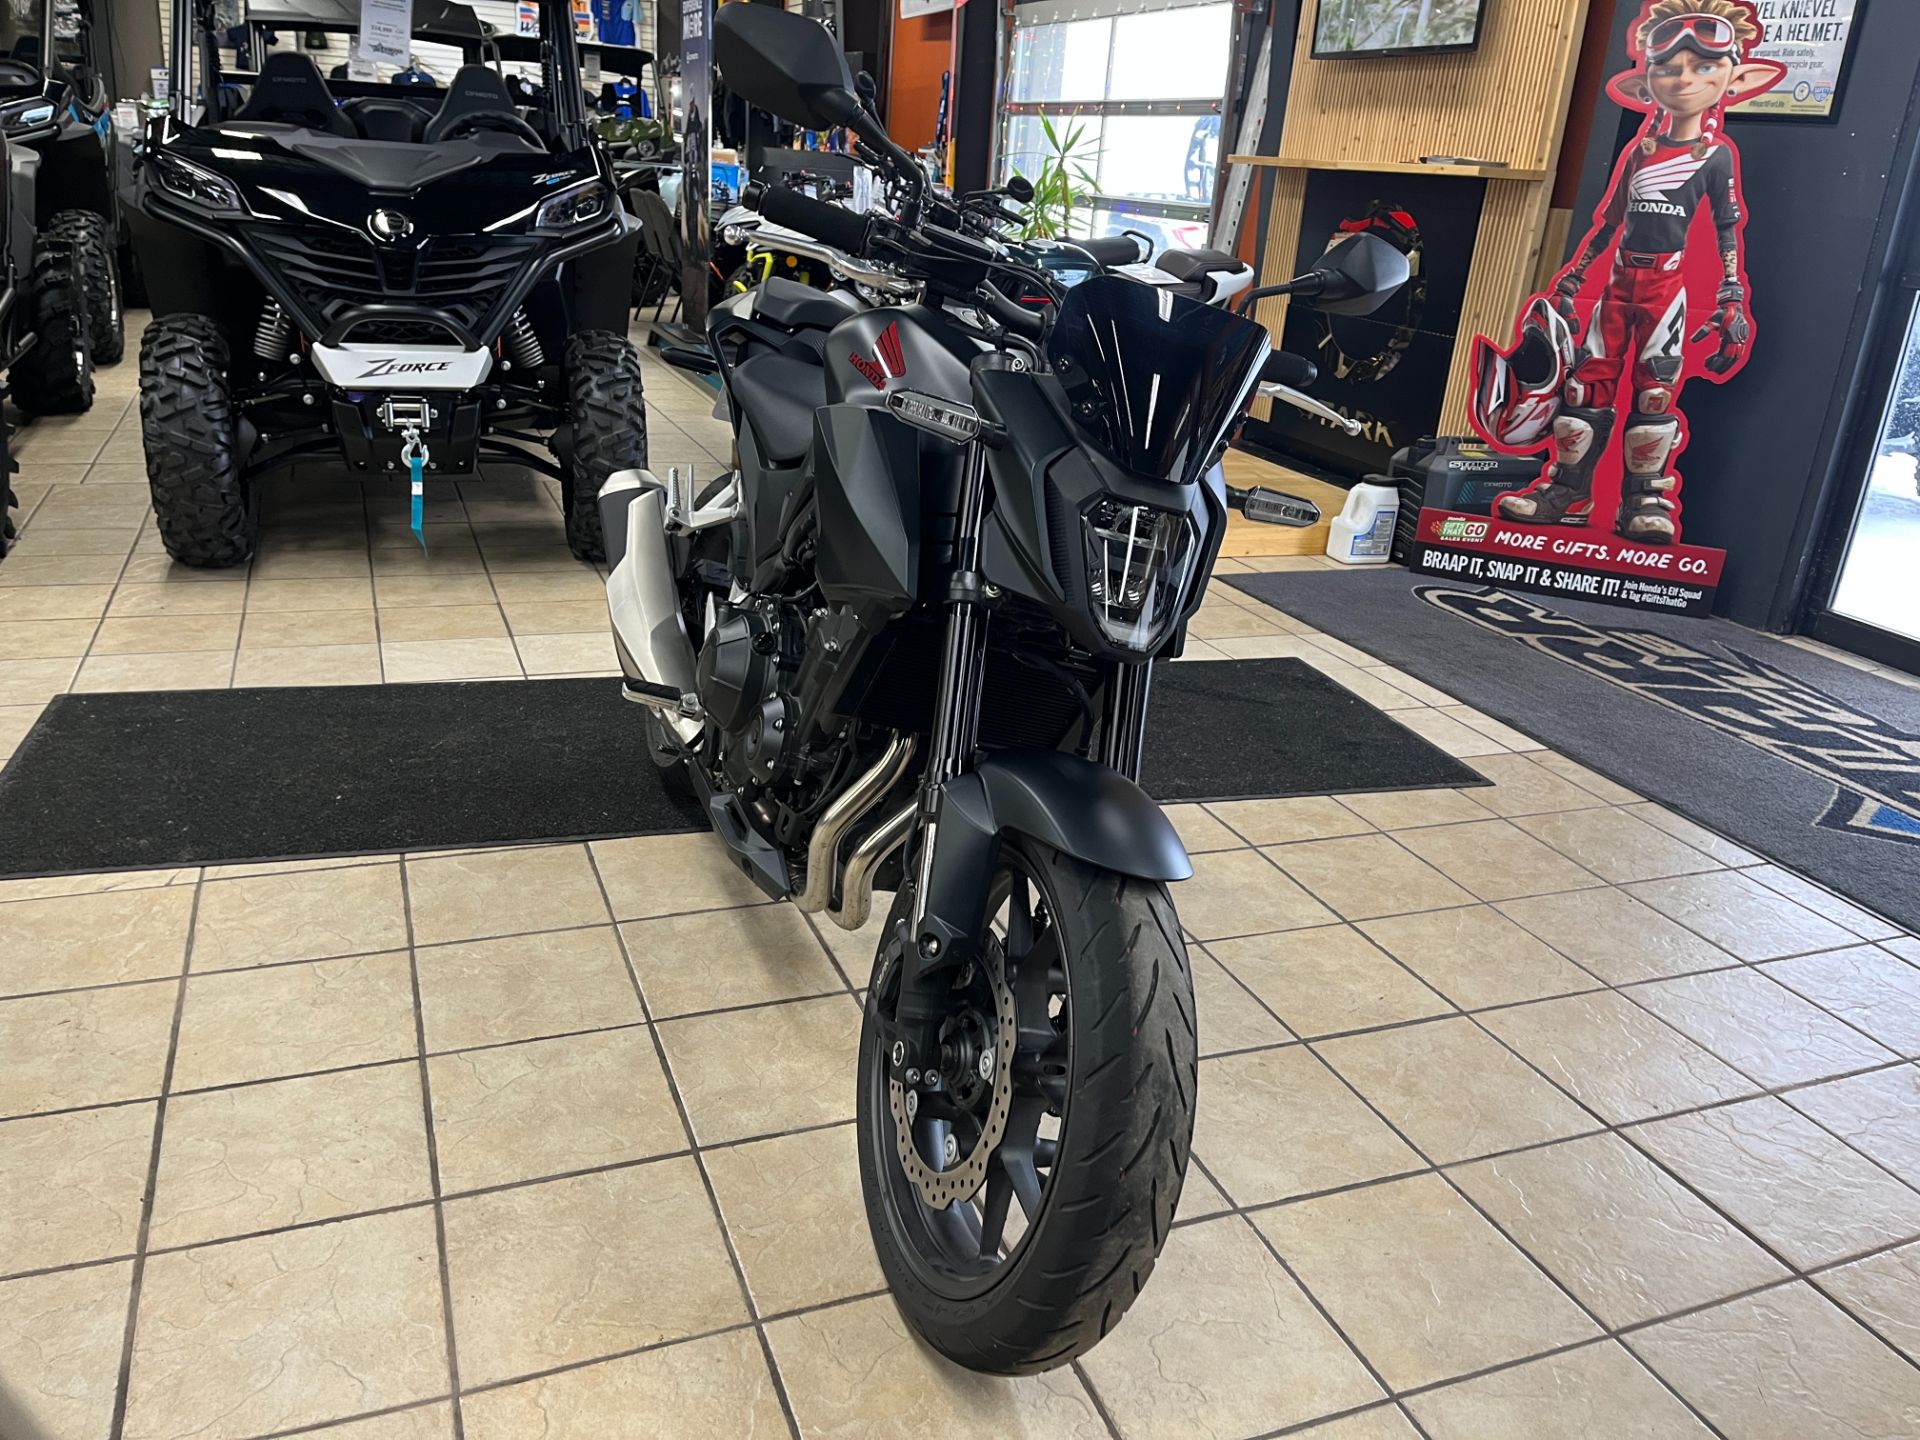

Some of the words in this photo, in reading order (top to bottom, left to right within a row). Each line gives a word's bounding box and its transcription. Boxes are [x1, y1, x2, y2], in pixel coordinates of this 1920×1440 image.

[1780, 0, 1836, 19] KNIEVEL
[1774, 24, 1783, 42] A
[1786, 22, 1843, 42] HELMET.
[1628, 202, 1687, 217] HONDA
[355, 358, 454, 379] ZFORCE
[848, 351, 887, 391] HONDA
[1465, 523, 1486, 536] GO
[1494, 530, 1548, 550] MORE
[1552, 539, 1610, 561] GIFTS.
[1616, 548, 1674, 569] MORE
[1678, 557, 1709, 575] GO.
[1422, 549, 1468, 573] BRAAP
[1469, 557, 1485, 578] IT,
[1486, 560, 1523, 582] SNAP
[1524, 566, 1540, 584] IT
[1539, 569, 1551, 587] &
[1553, 571, 1601, 595] SHARE
[1601, 577, 1621, 597] IT!
[1621, 590, 1628, 599] &
[1629, 590, 1641, 603] Tag
[1641, 594, 1688, 609] #GiftsThatGo
[1623, 580, 1638, 591] Join
[1638, 582, 1668, 595] Honda's
[1667, 586, 1679, 597] Elf
[1678, 588, 1702, 600] Squad
